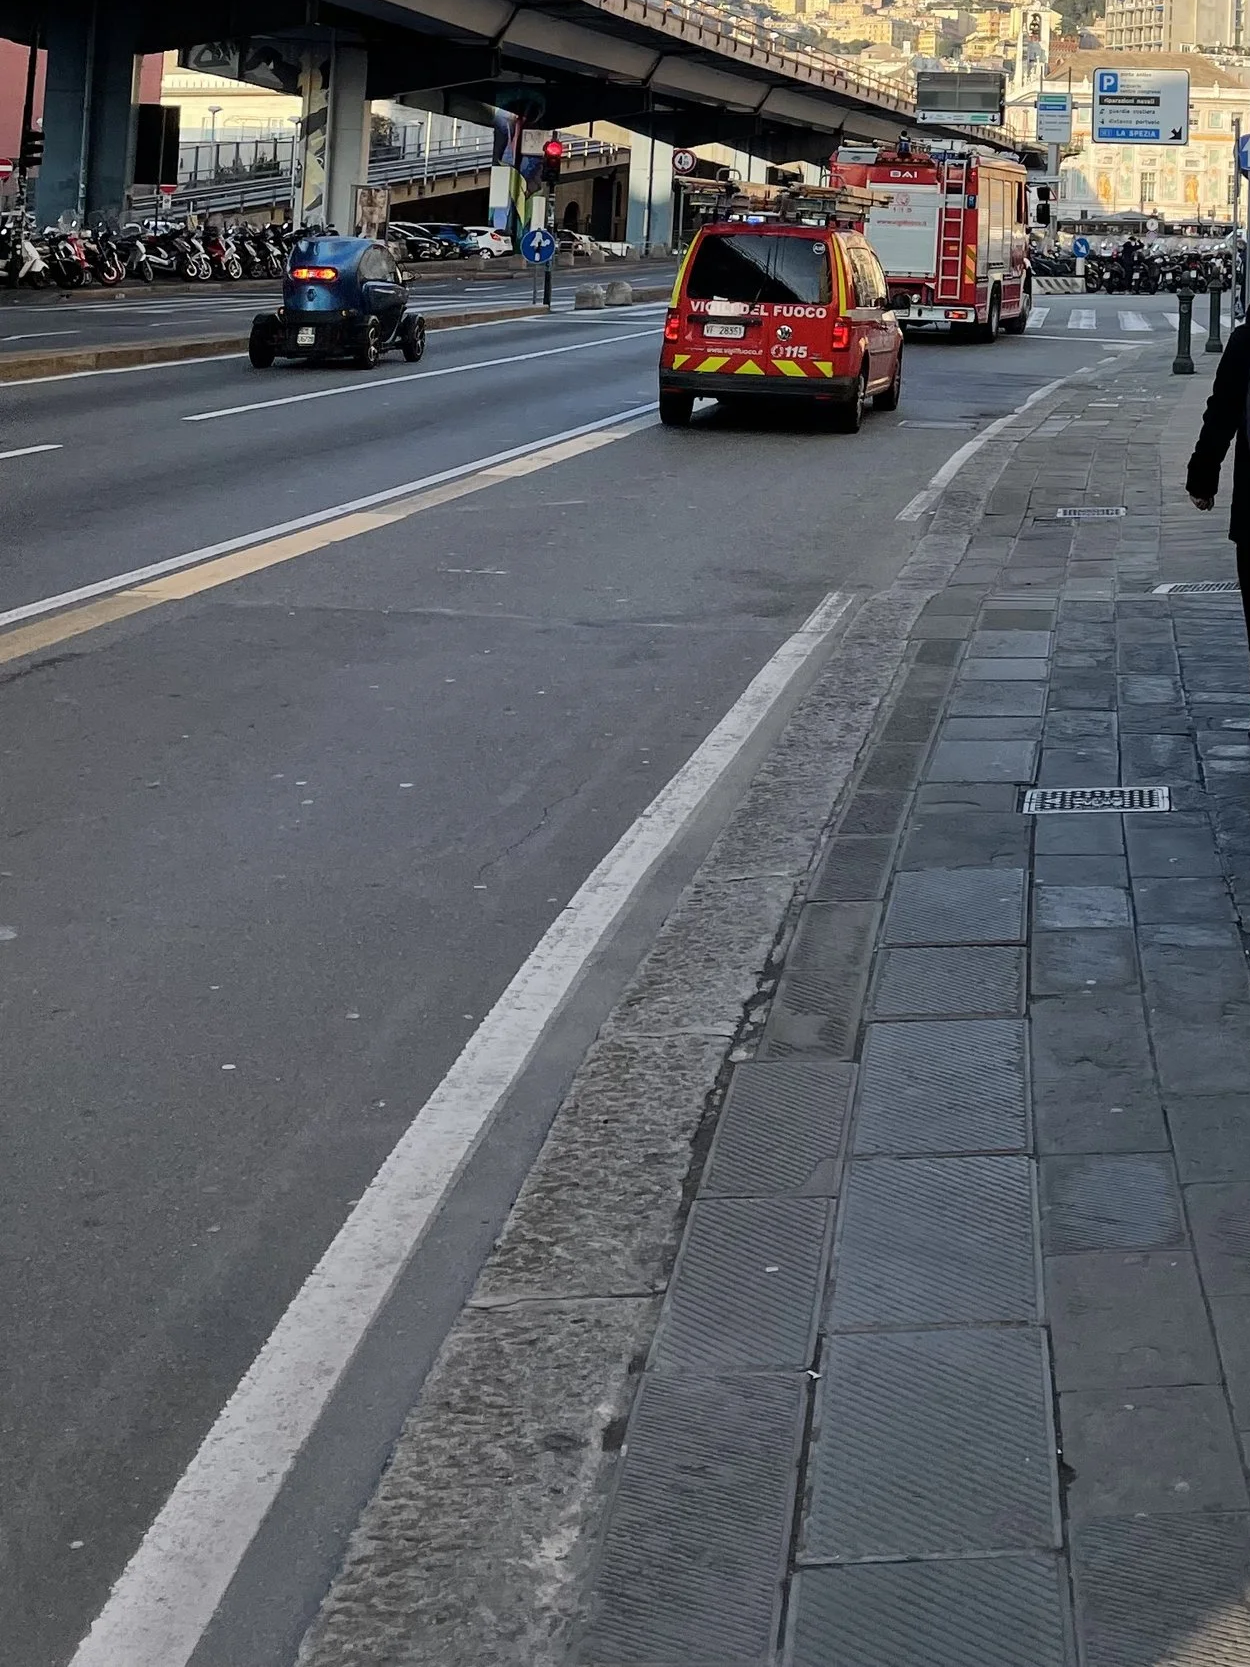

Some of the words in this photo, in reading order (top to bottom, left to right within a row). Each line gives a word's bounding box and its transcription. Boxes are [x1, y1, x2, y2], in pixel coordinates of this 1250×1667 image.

[1129, 130, 1157, 138] SPEZIA
[741, 302, 769, 317] DEL
[773, 305, 828, 319] FUOCO
[785, 346, 808, 358] 115
